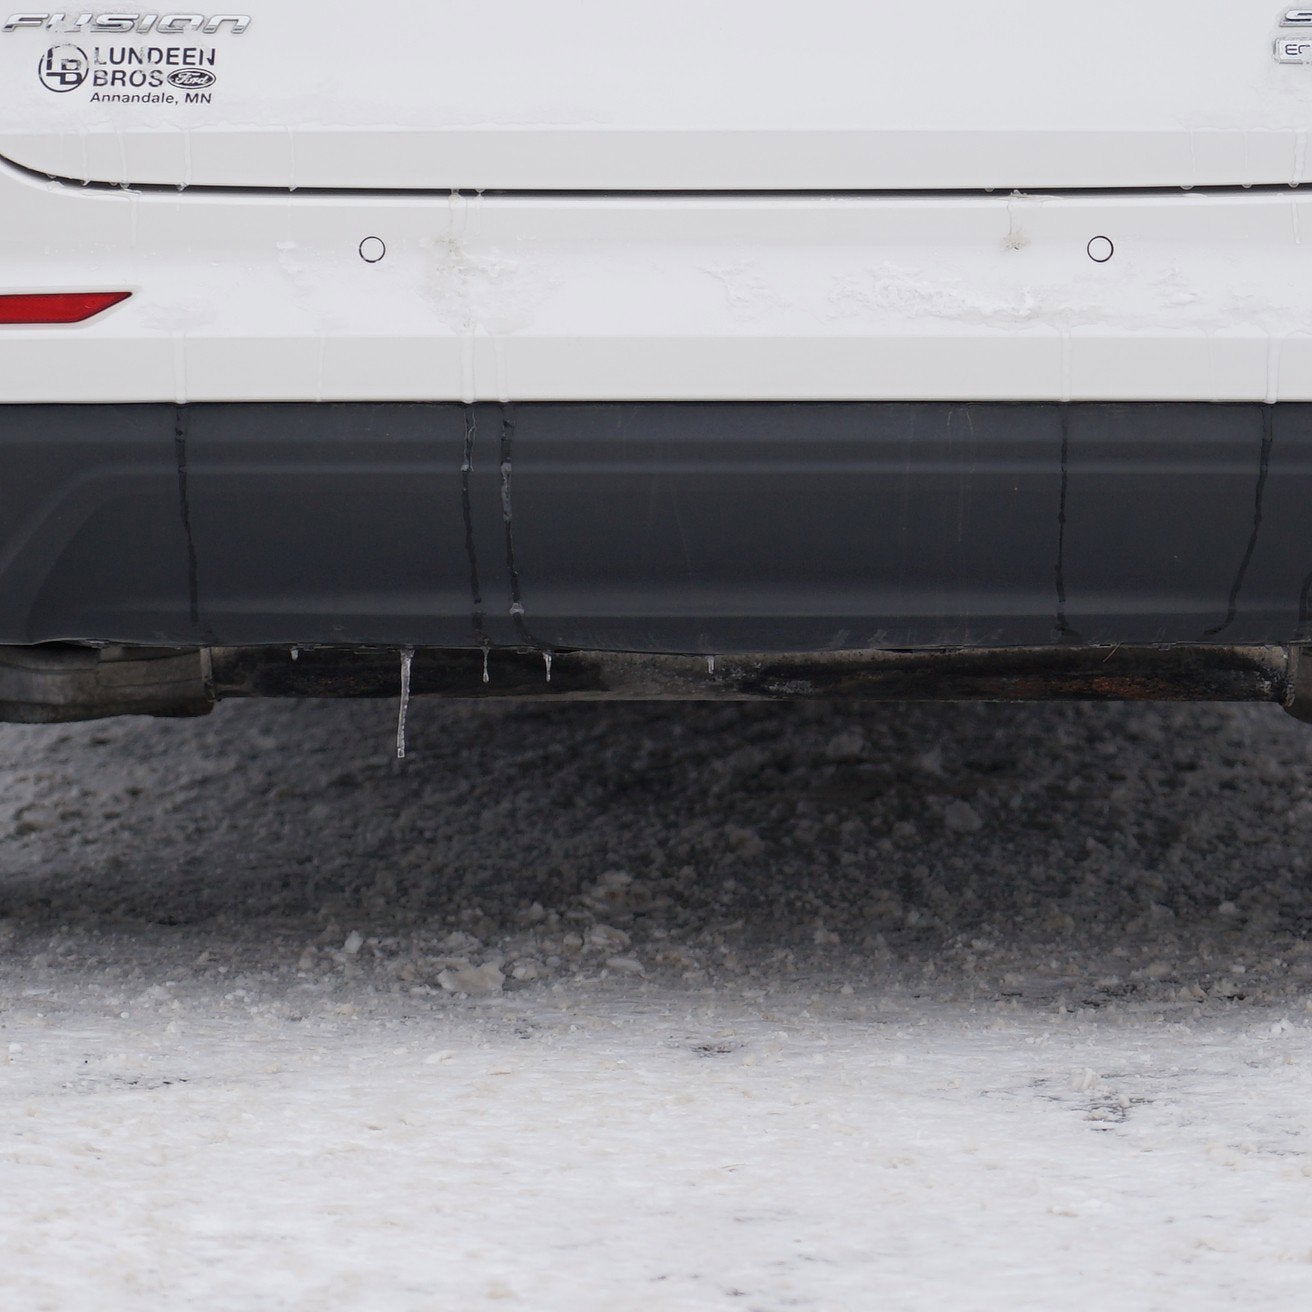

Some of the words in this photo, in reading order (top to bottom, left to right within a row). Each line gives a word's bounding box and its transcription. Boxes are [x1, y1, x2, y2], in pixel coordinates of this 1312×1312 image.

[93, 46, 216, 67] LUNDEEN
[92, 69, 164, 88] BROS
[90, 92, 179, 106] Annandale,
[184, 93, 212, 105] MN
